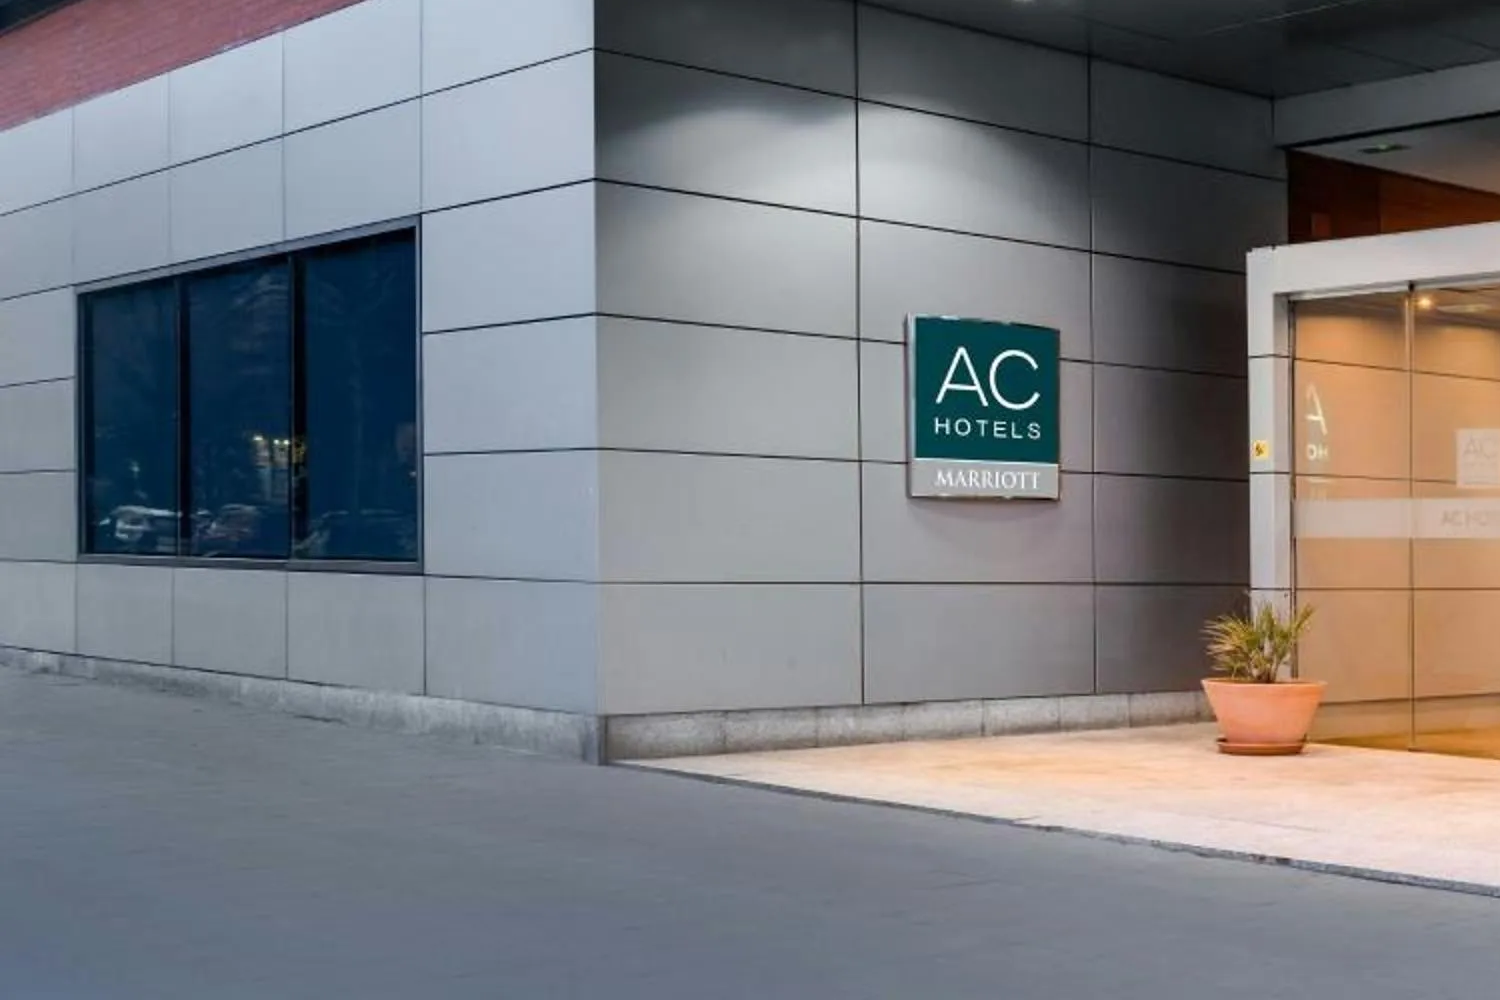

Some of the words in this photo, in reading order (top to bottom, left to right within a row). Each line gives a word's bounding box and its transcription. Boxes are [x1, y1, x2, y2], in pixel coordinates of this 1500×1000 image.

[935, 346, 1041, 410] AC
[934, 417, 1041, 440] HOTELS
[934, 470, 1041, 490] MARRIOTT
